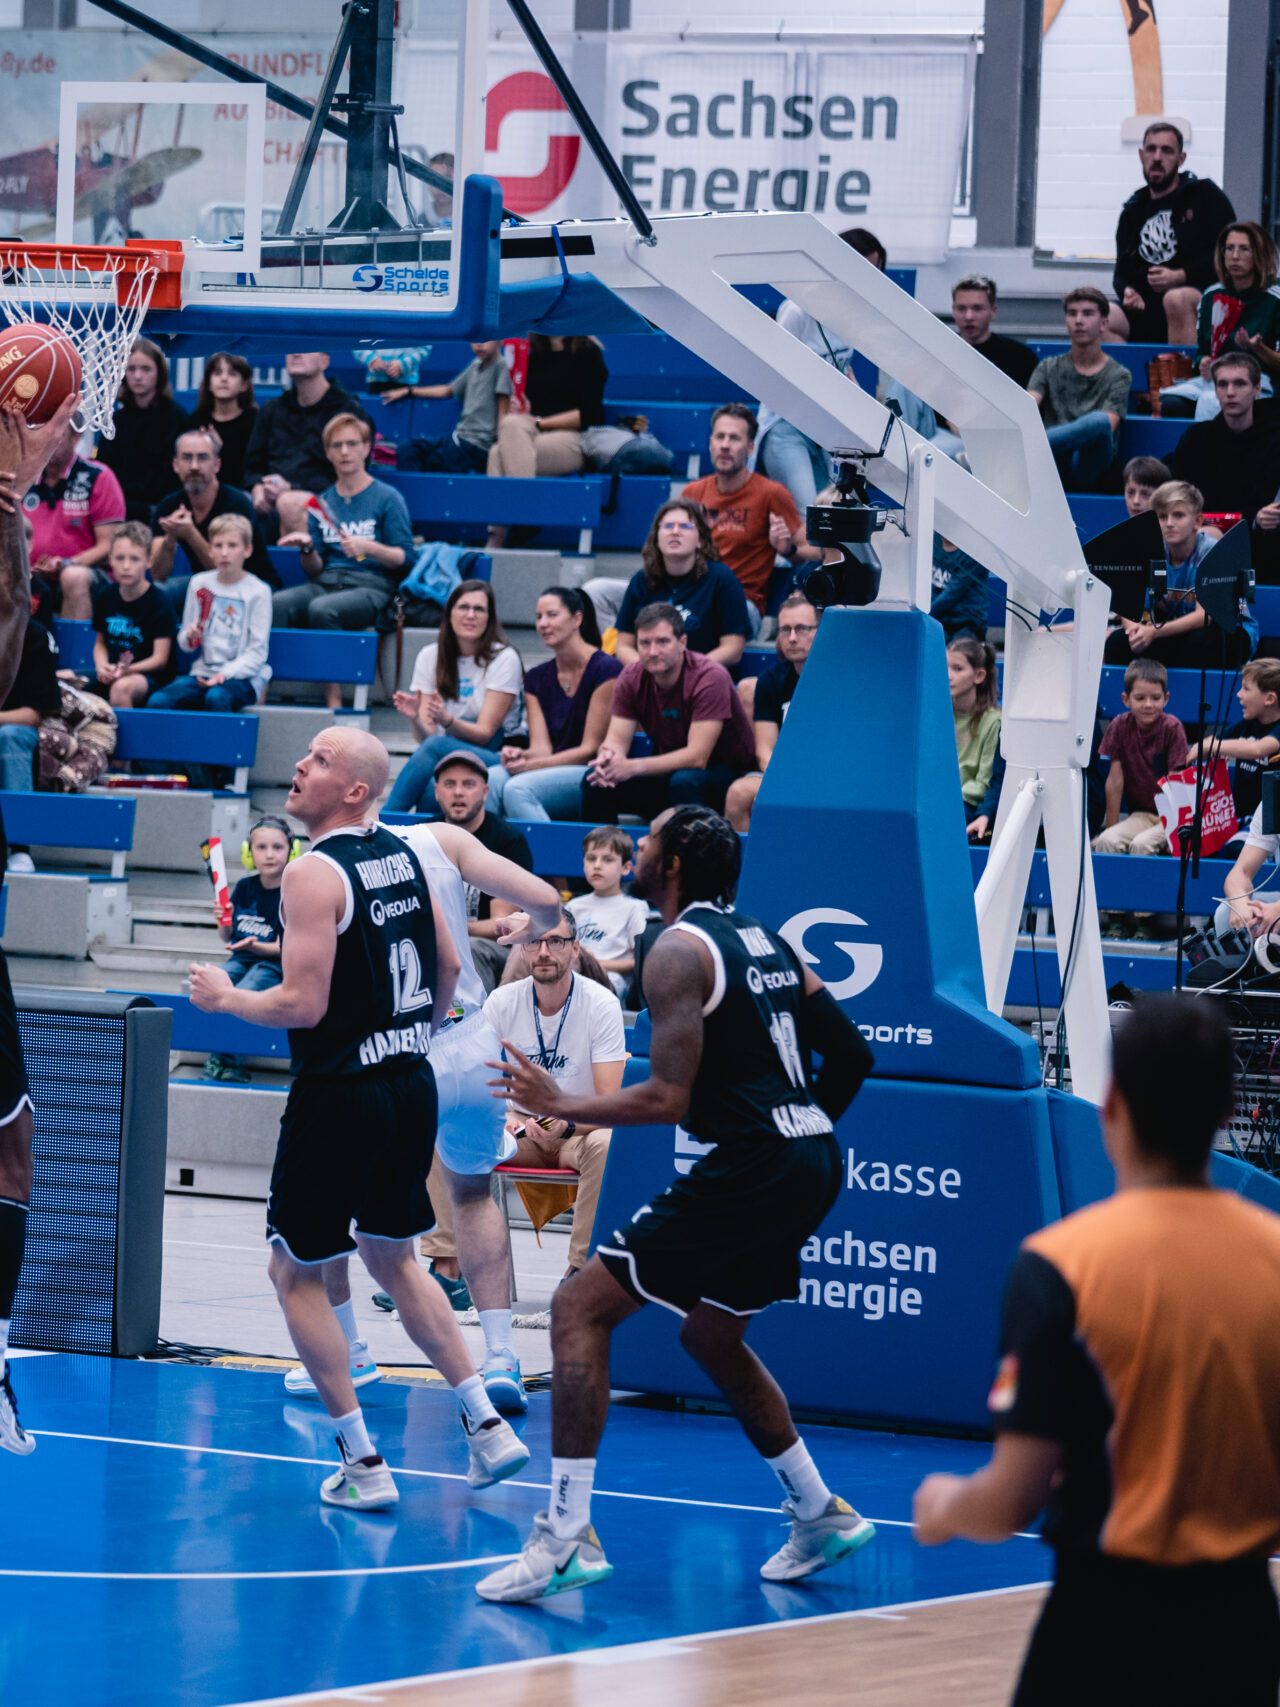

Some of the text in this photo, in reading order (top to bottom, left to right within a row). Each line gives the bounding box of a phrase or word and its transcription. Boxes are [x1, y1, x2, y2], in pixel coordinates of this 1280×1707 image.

[621, 79, 899, 141] Sachsen
[621, 154, 871, 214] Energie
[383, 279, 449, 295] Sports
[384, 266, 449, 280] Schelde
[384, 895, 422, 919] VEOLIA
[388, 937, 434, 1017] 12
[762, 969, 800, 989] EOLIA
[855, 1022, 934, 1046] ports
[799, 1230, 938, 1274] achsen
[797, 1277, 923, 1321] nergie
